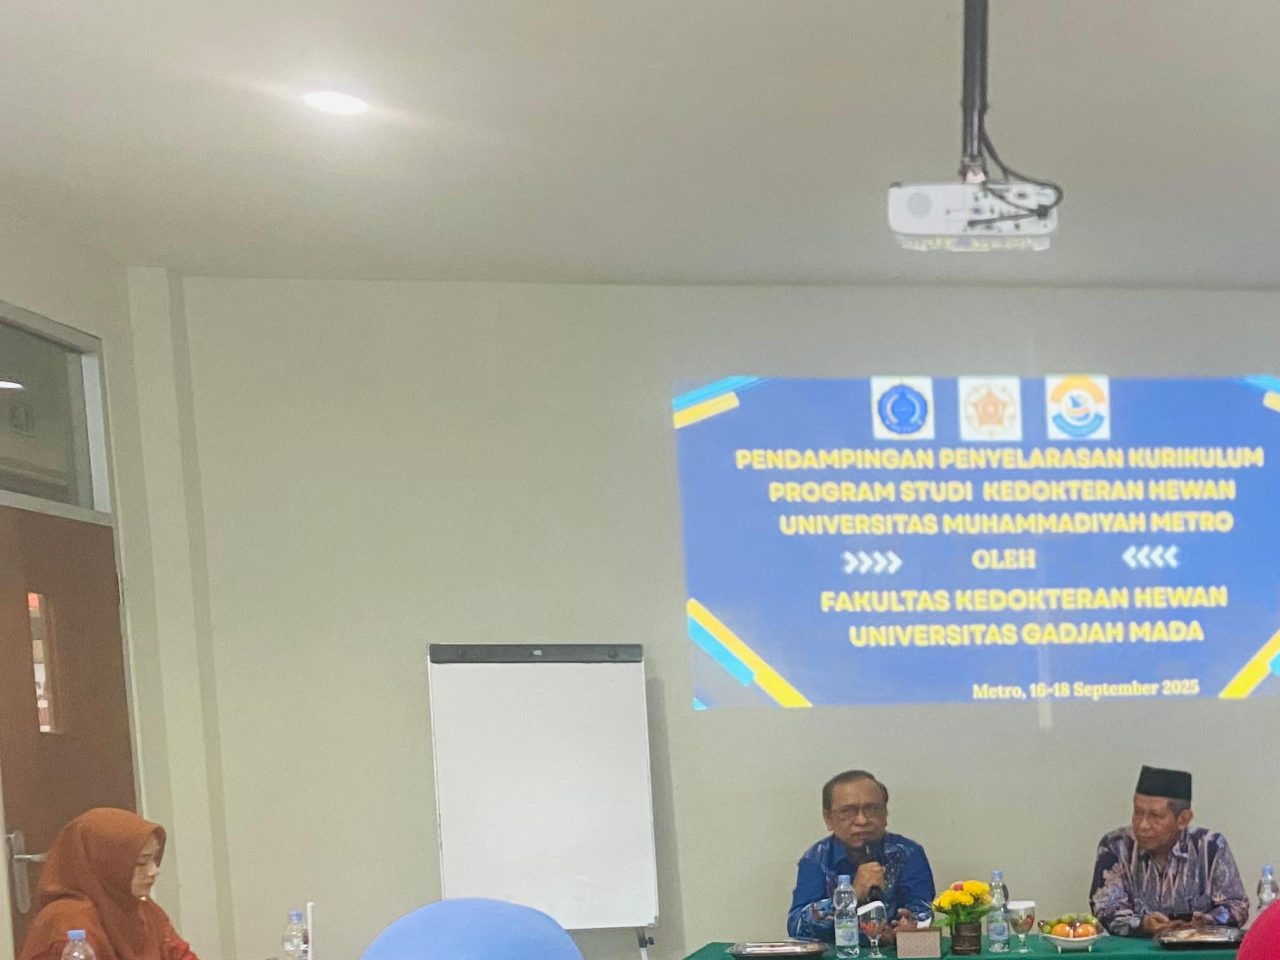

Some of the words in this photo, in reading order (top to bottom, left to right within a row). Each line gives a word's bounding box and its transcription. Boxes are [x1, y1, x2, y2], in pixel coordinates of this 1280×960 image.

[736, 449, 933, 470] PENDAMPINGAN
[939, 447, 1124, 470] PENYELARASAN
[1128, 446, 1264, 469] KURIKULUM
[769, 481, 895, 502] PROGRAM
[900, 480, 972, 502] STUDI
[983, 480, 1143, 502] KEDOKTERAN
[1149, 479, 1236, 501] HEWAN
[779, 514, 938, 535] UNIVERSITAS
[943, 513, 1146, 534] MUHAMMADIYAH
[1151, 511, 1234, 533] METRO
[971, 548, 1036, 570] OLEH
[820, 589, 950, 613] FAKULTAS
[955, 587, 1128, 611] KEDOKTERAN
[1134, 586, 1228, 609] HEWAN
[849, 624, 1018, 648] UNIVERSITAS
[1022, 621, 1124, 646] GADJAH
[1129, 620, 1205, 644] MADA
[972, 683, 1026, 700] Metro,
[1030, 681, 1070, 698] 16-18
[1073, 679, 1159, 701] September
[1162, 678, 1200, 695] 2025
